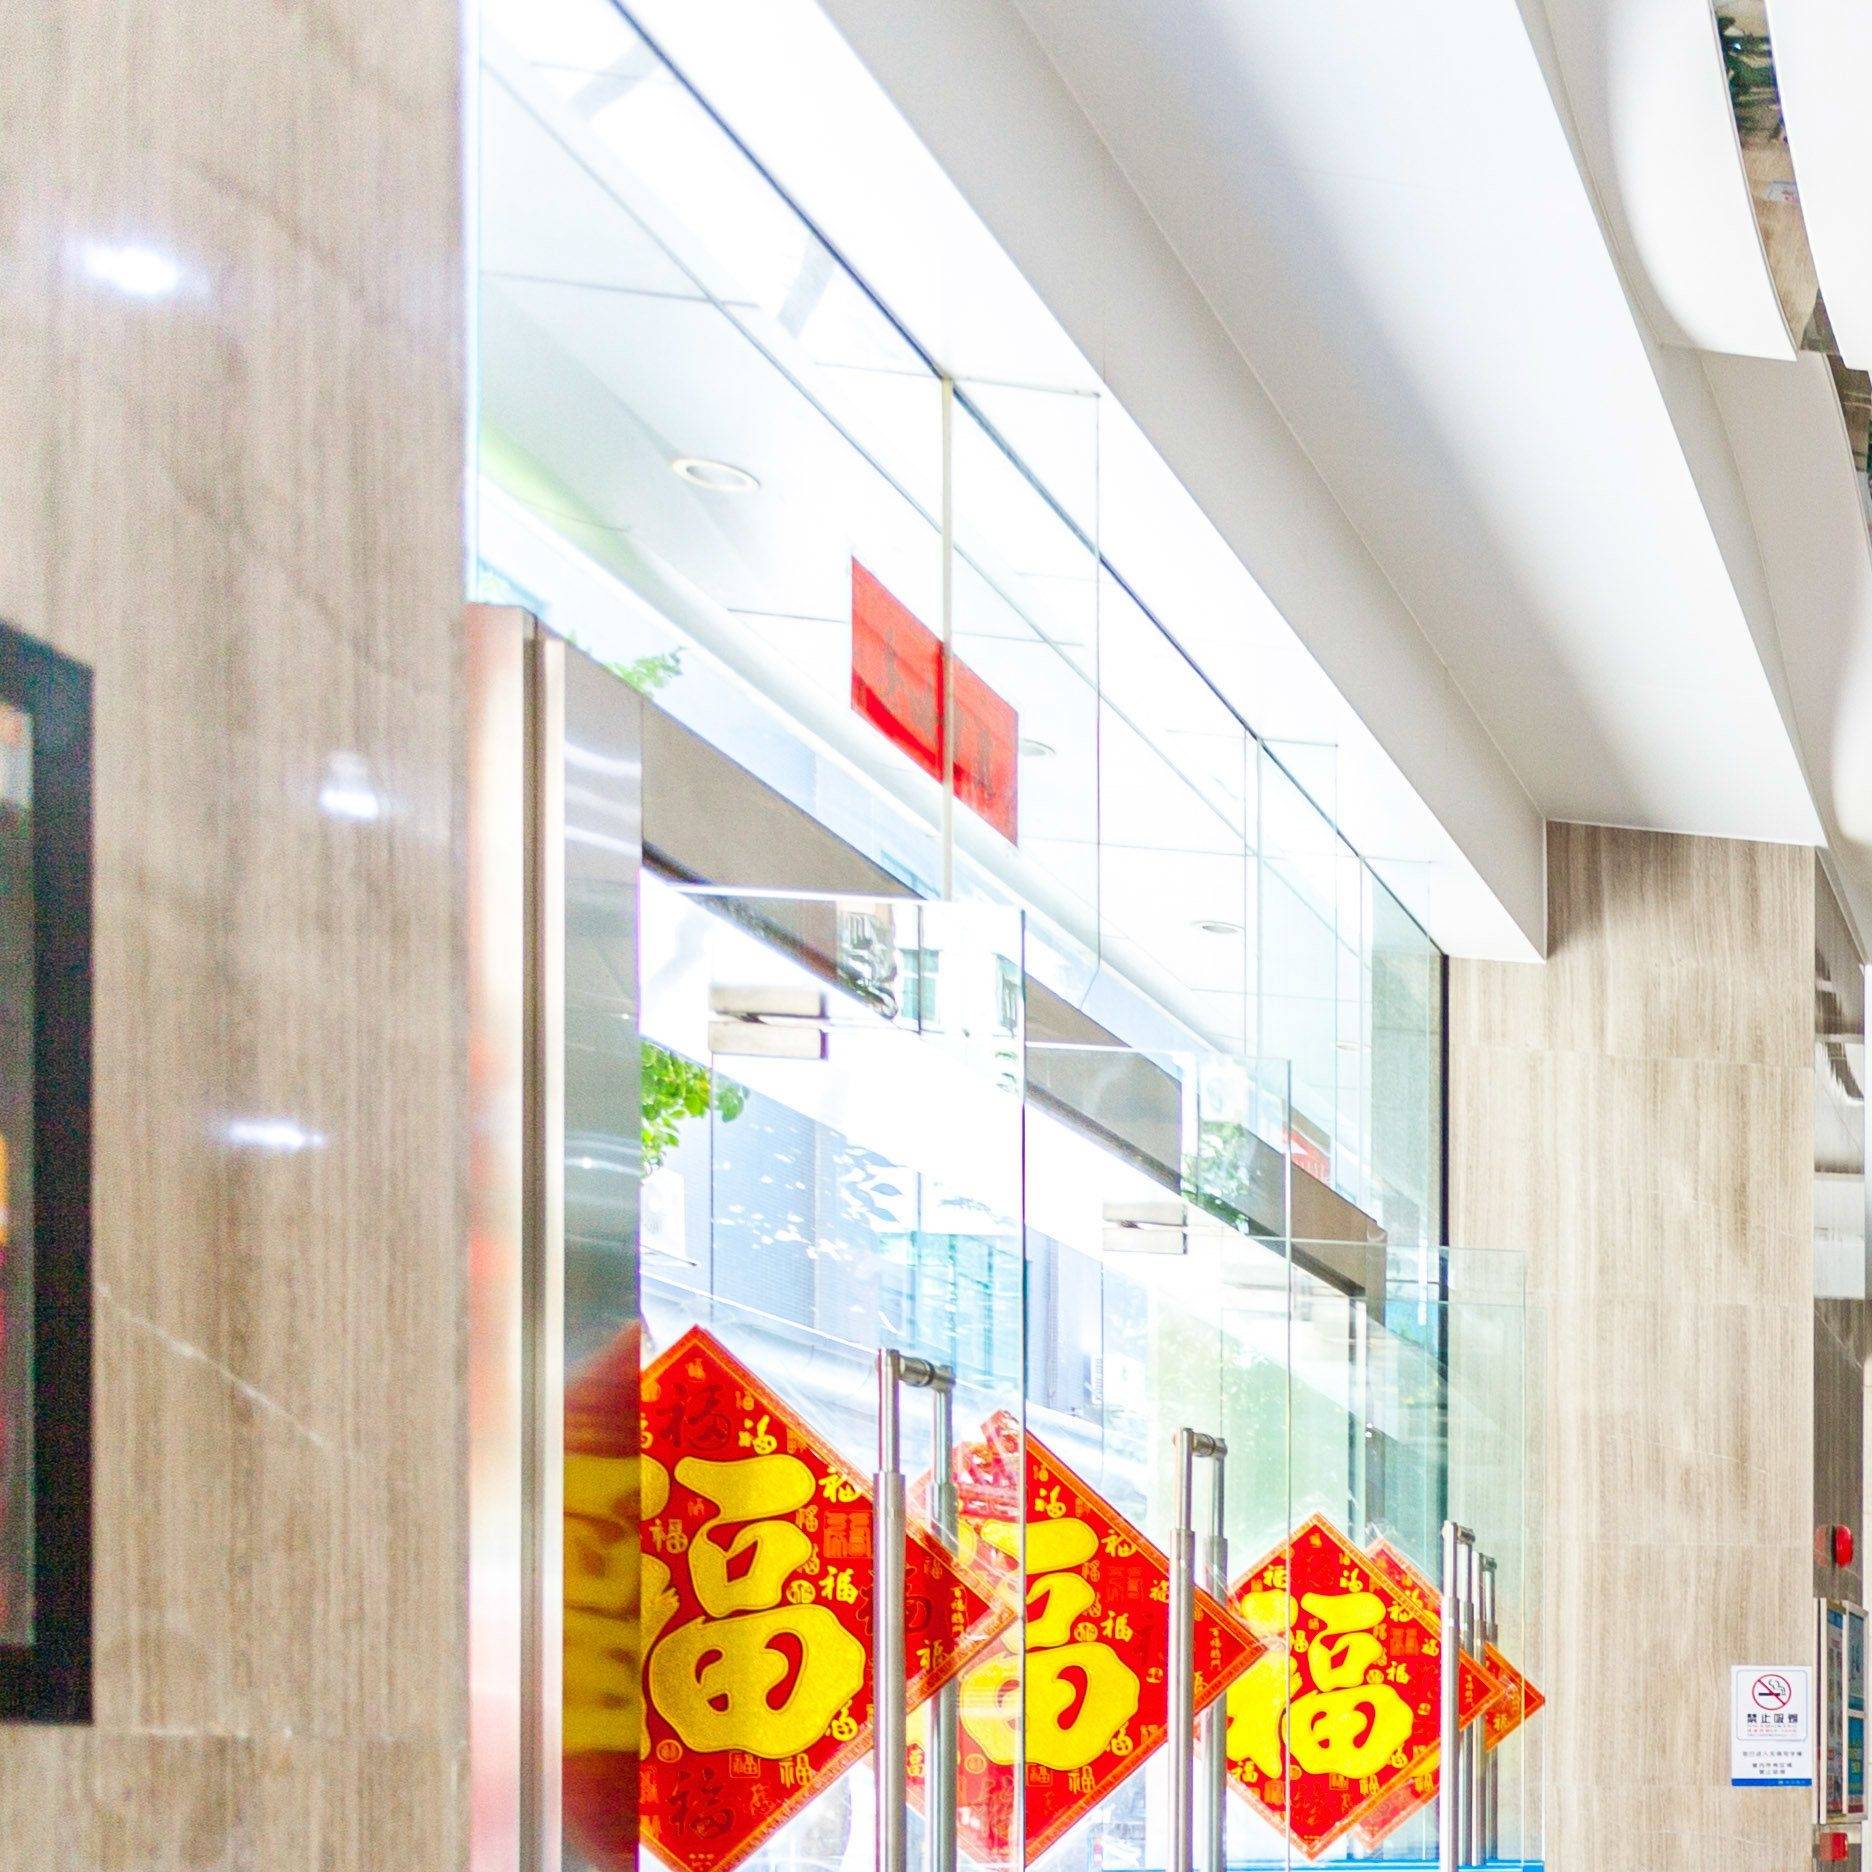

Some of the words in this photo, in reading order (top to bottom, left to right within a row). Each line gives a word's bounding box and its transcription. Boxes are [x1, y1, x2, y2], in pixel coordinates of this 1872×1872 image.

[640, 1453, 863, 1759] 福
[819, 1565, 859, 1605] 福
[1101, 1609, 1133, 1642] 福
[1226, 1588, 1414, 1779] 福
